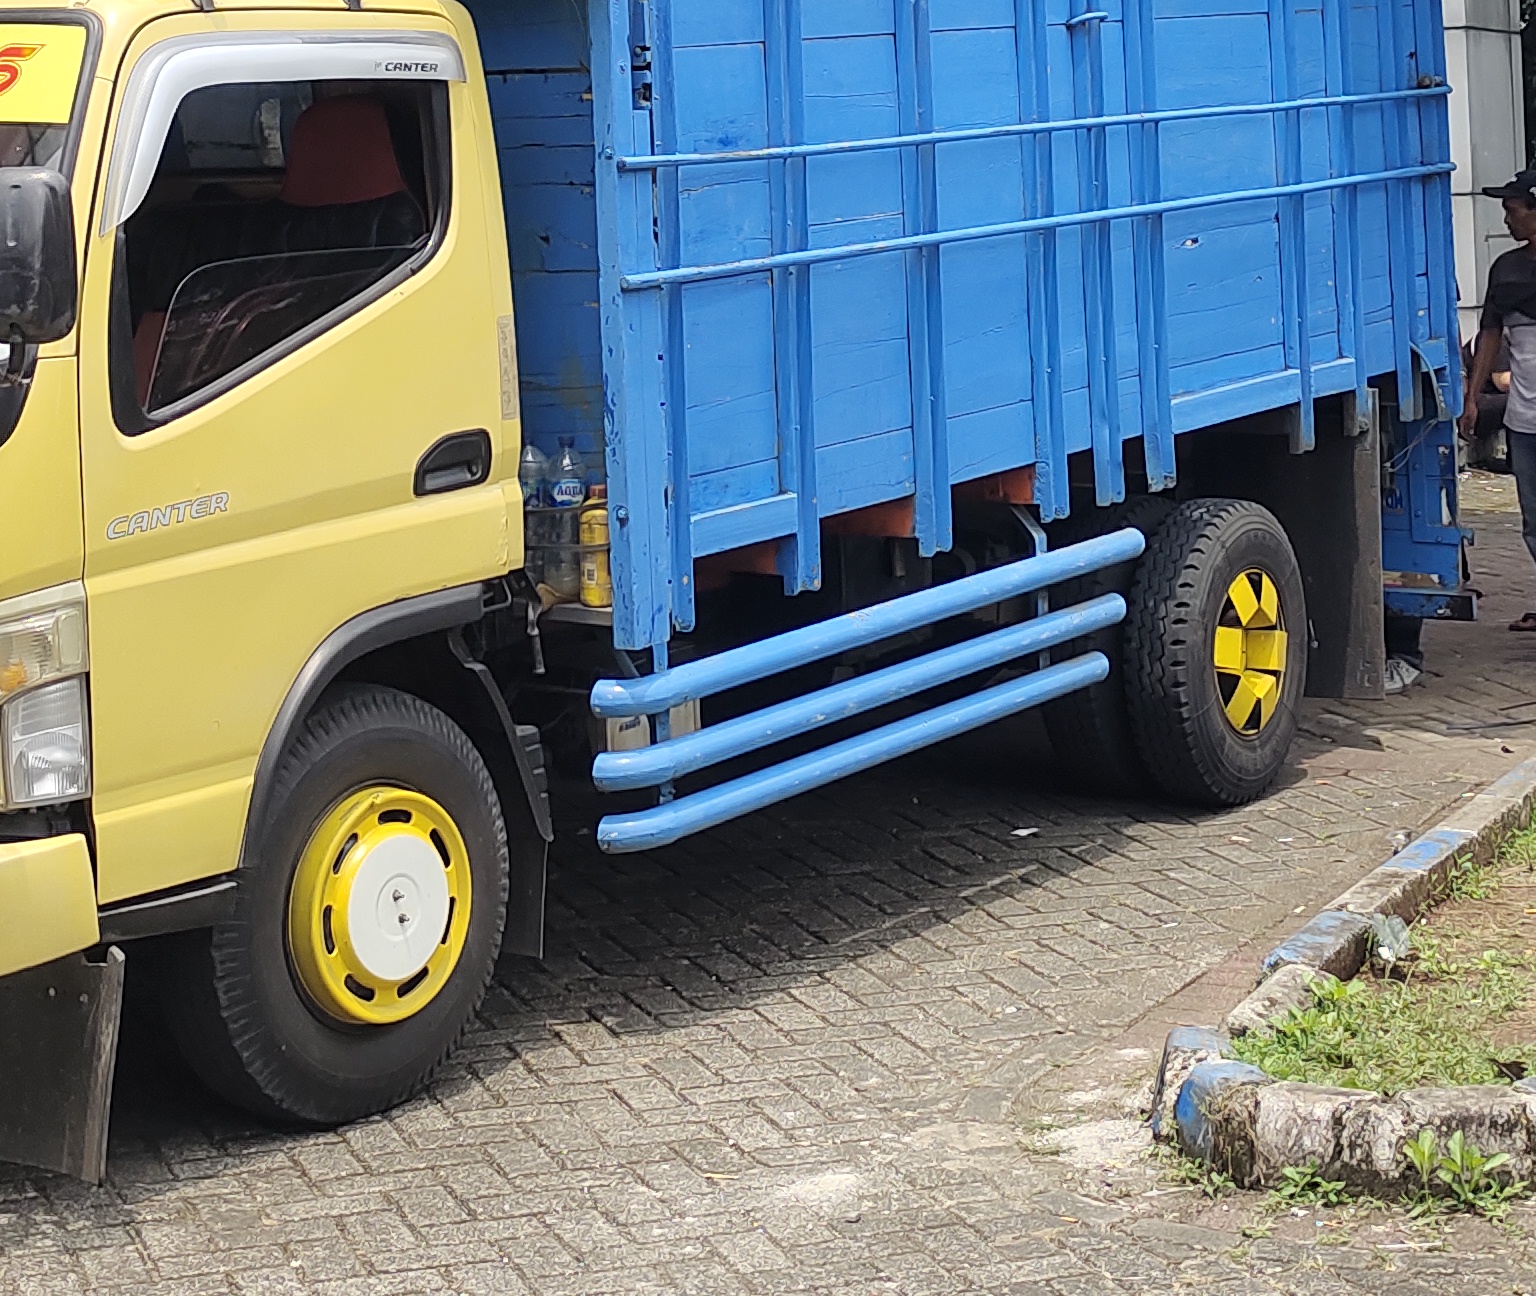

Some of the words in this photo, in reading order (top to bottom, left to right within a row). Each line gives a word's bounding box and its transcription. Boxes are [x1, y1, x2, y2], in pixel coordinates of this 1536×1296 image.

[384, 61, 439, 73] CANTER
[556, 485, 583, 497] AQUA
[106, 491, 230, 540] CANTER
